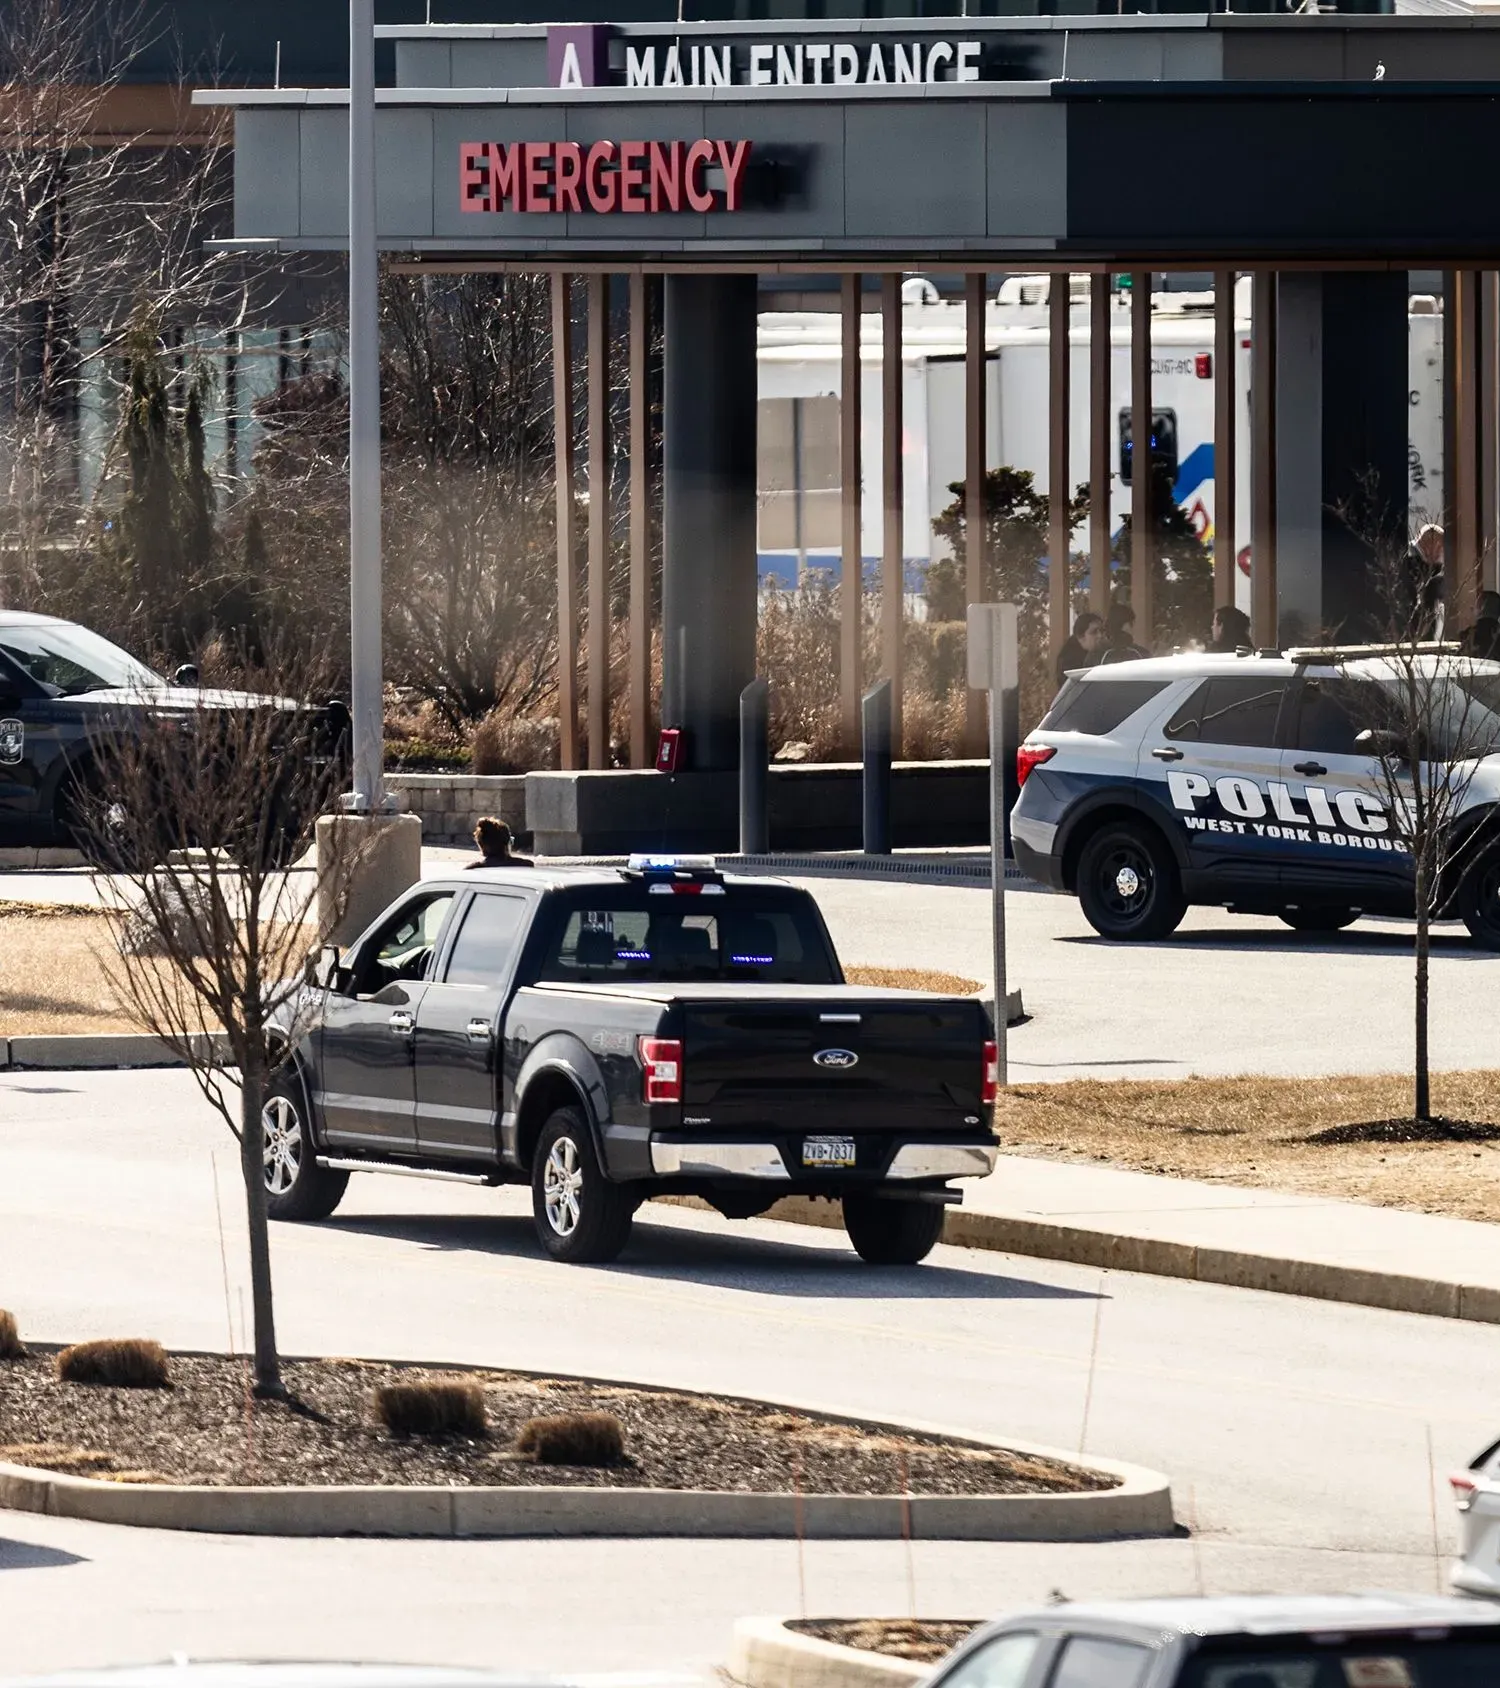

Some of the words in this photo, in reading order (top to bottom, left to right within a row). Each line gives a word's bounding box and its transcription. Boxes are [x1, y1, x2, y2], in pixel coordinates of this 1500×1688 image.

[560, 43, 583, 88] A
[626, 45, 731, 87] MAIN
[750, 41, 982, 85] ENTRANCE
[459, 139, 752, 214] EMERGENCY
[1408, 444, 1427, 491] ORK
[1183, 816, 1246, 834] WEST
[1253, 823, 1312, 842] YORK
[1317, 832, 1413, 853] BOROUG
